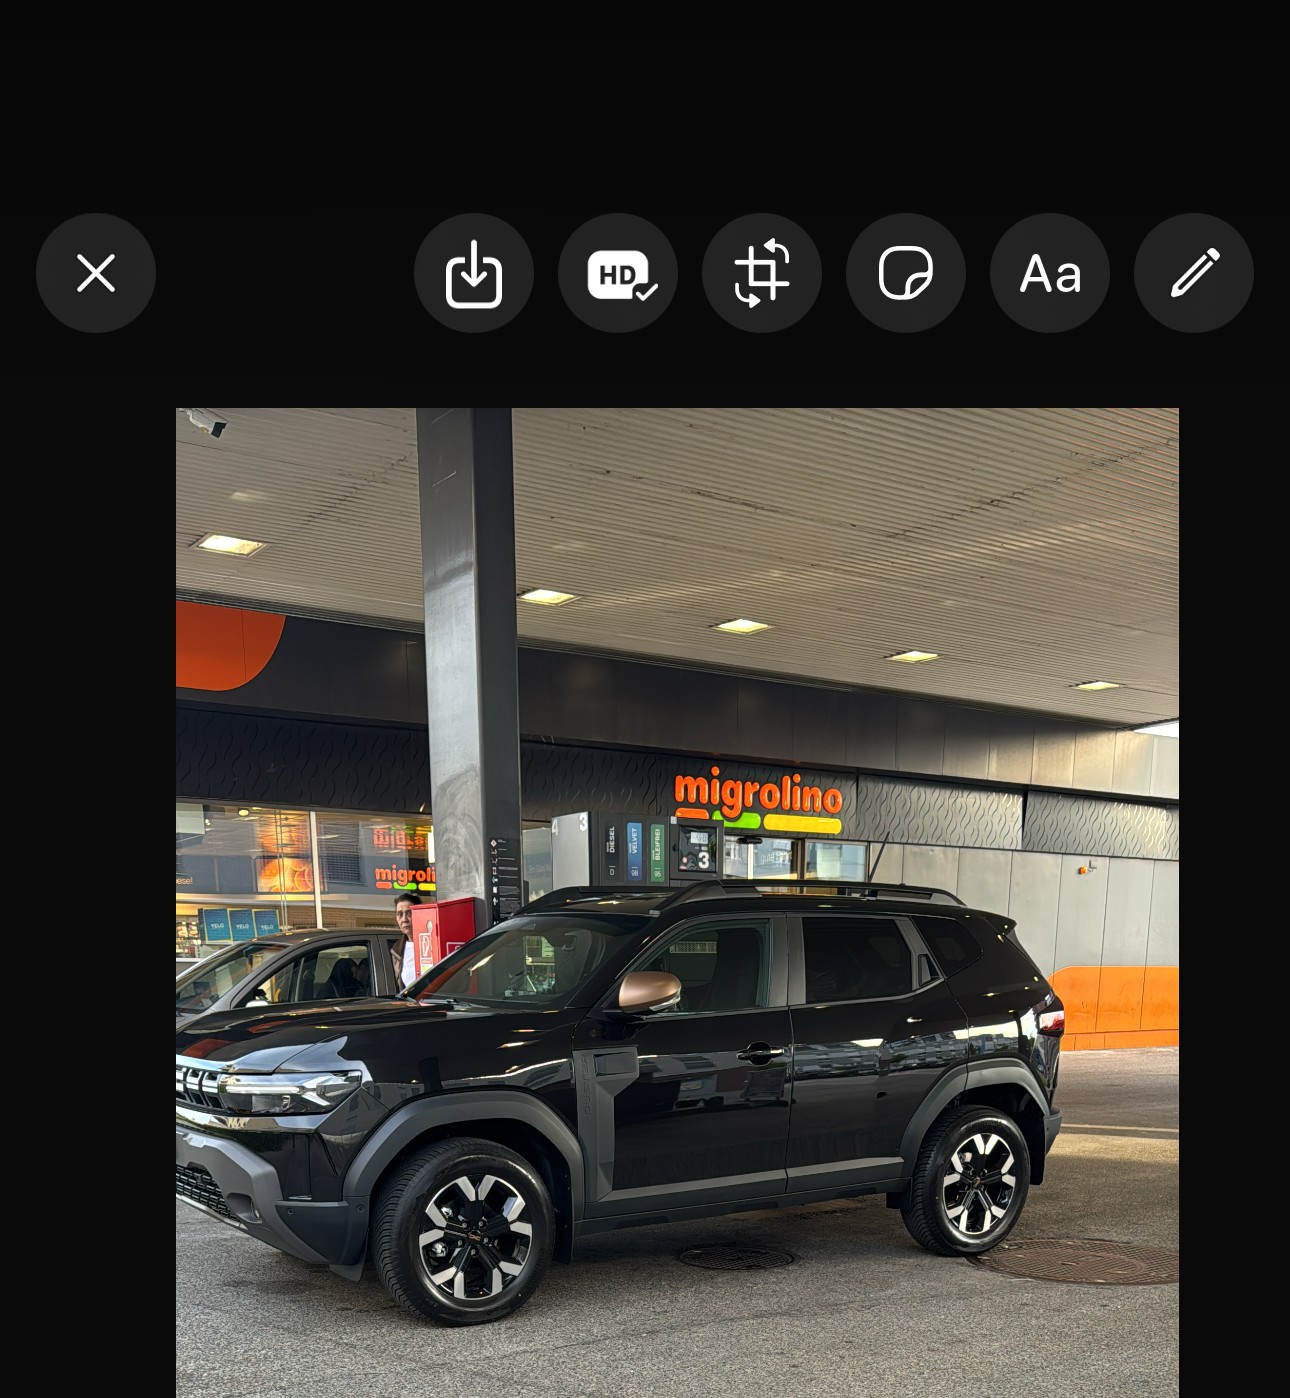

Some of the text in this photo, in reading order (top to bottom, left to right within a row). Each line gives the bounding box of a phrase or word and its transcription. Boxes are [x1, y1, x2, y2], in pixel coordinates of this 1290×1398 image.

[674, 765, 844, 819] migrolino
[551, 818, 559, 836] 4
[579, 812, 588, 832] 3
[698, 851, 710, 869] 3
